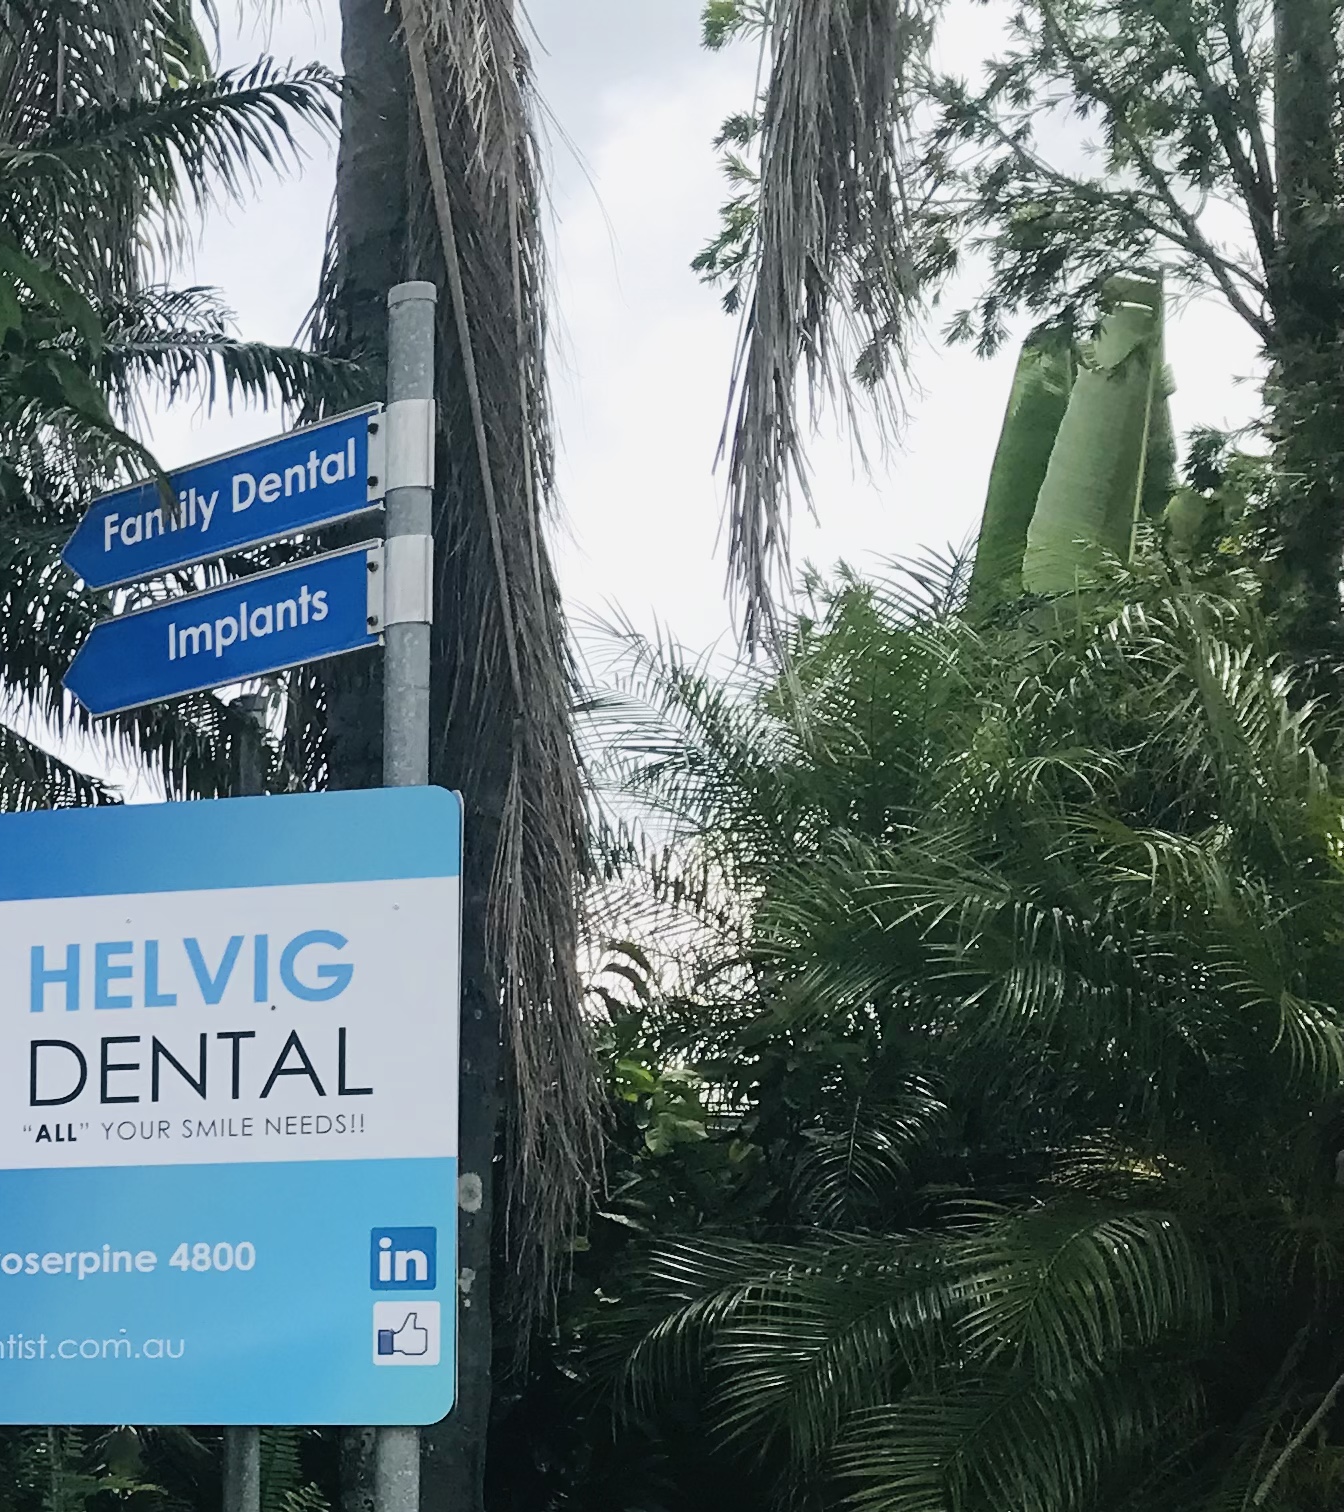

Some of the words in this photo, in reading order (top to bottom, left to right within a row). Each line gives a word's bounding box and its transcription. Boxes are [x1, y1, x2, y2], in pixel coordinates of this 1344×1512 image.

[231, 436, 358, 514] Dental
[167, 583, 330, 662] Implants
[29, 929, 355, 1014] HELVIG
[29, 1026, 375, 1107] DENTAL
[100, 1119, 172, 1142] YOUR
[180, 1117, 254, 1139] SMILE
[264, 1113, 366, 1136] NEEDS!!
[168, 1241, 257, 1273] 4800
[378, 1236, 429, 1283] in
